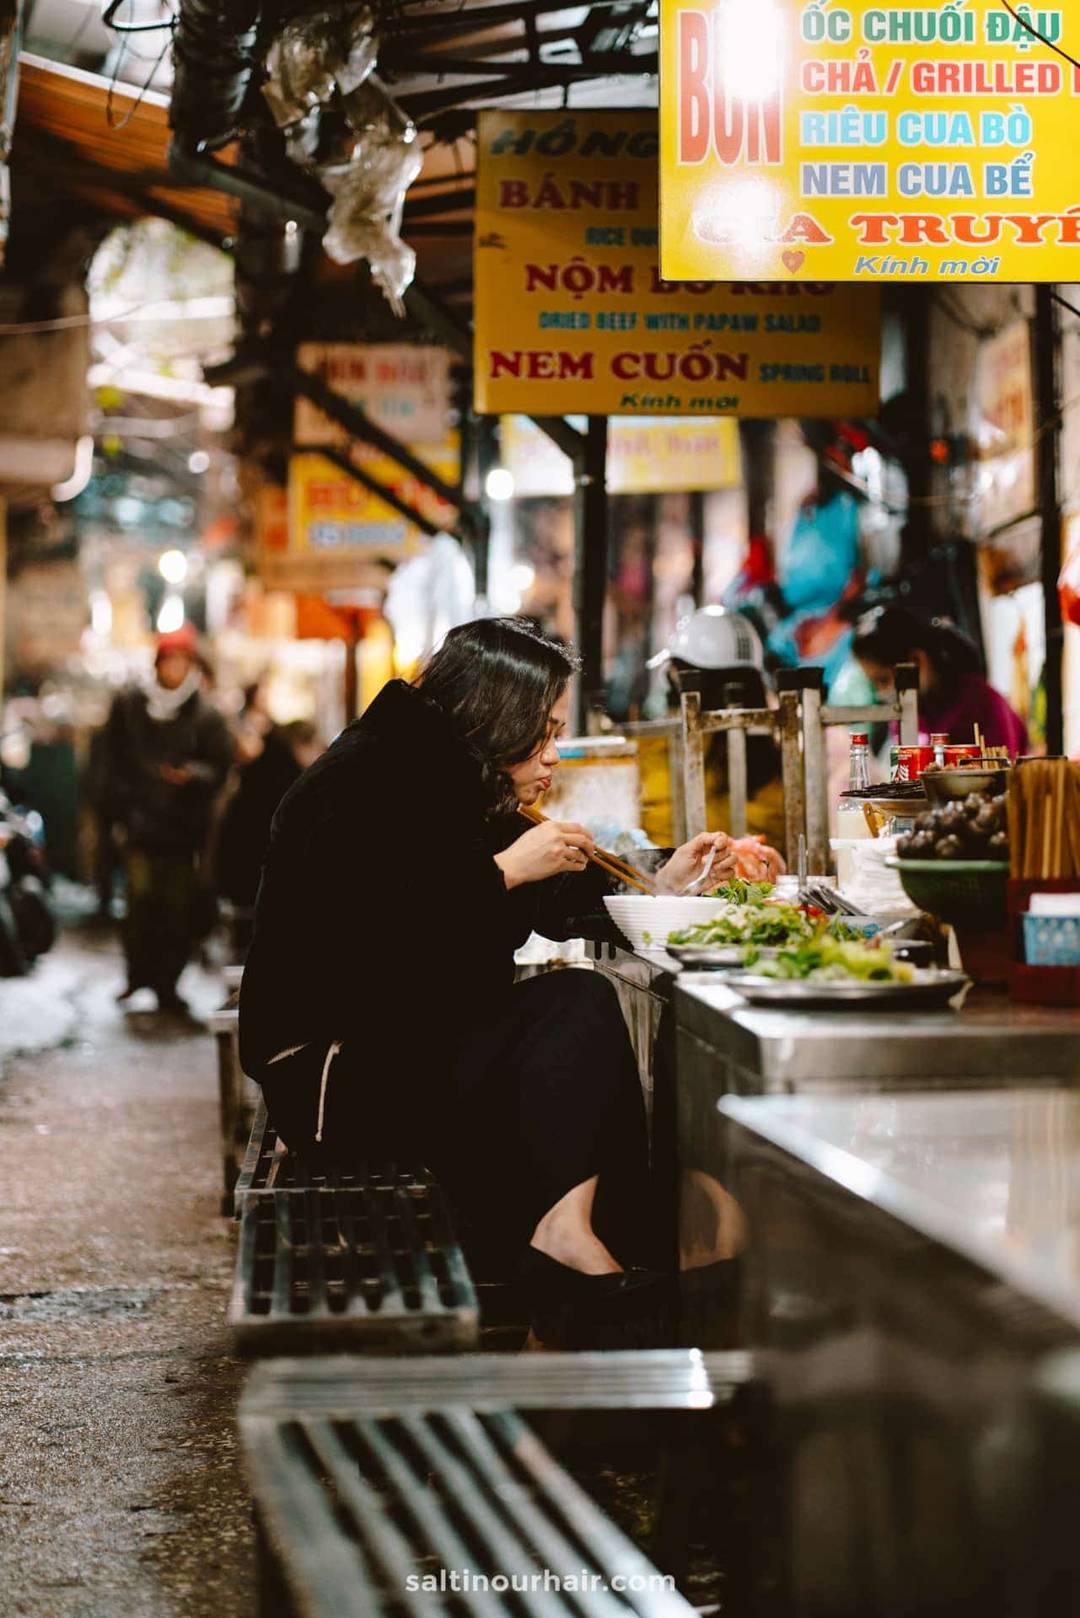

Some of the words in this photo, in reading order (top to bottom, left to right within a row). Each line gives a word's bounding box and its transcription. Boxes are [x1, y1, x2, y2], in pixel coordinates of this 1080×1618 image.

[803, 0, 850, 42] ỐC
[864, 0, 973, 42] CHUỐI
[986, 6, 1060, 49] ĐẬU
[803, 49, 876, 93] CHẢ
[913, 62, 1060, 93] GRILLED
[803, 106, 886, 144] RIÊU
[900, 112, 973, 144] CUA
[982, 104, 1031, 144] BÒ
[499, 171, 639, 211] BÁNH
[803, 164, 886, 195] NEM
[900, 164, 973, 195] CUA
[986, 153, 1034, 195] BỂ
[526, 256, 633, 299] NỘM
[855, 256, 928, 275] Kính
[939, 257, 1000, 275] mời
[596, 311, 637, 330] BEEF
[645, 312, 689, 331] WITH
[765, 313, 821, 333] SALAD
[489, 351, 594, 381] NEM
[611, 340, 748, 381] CUỐN
